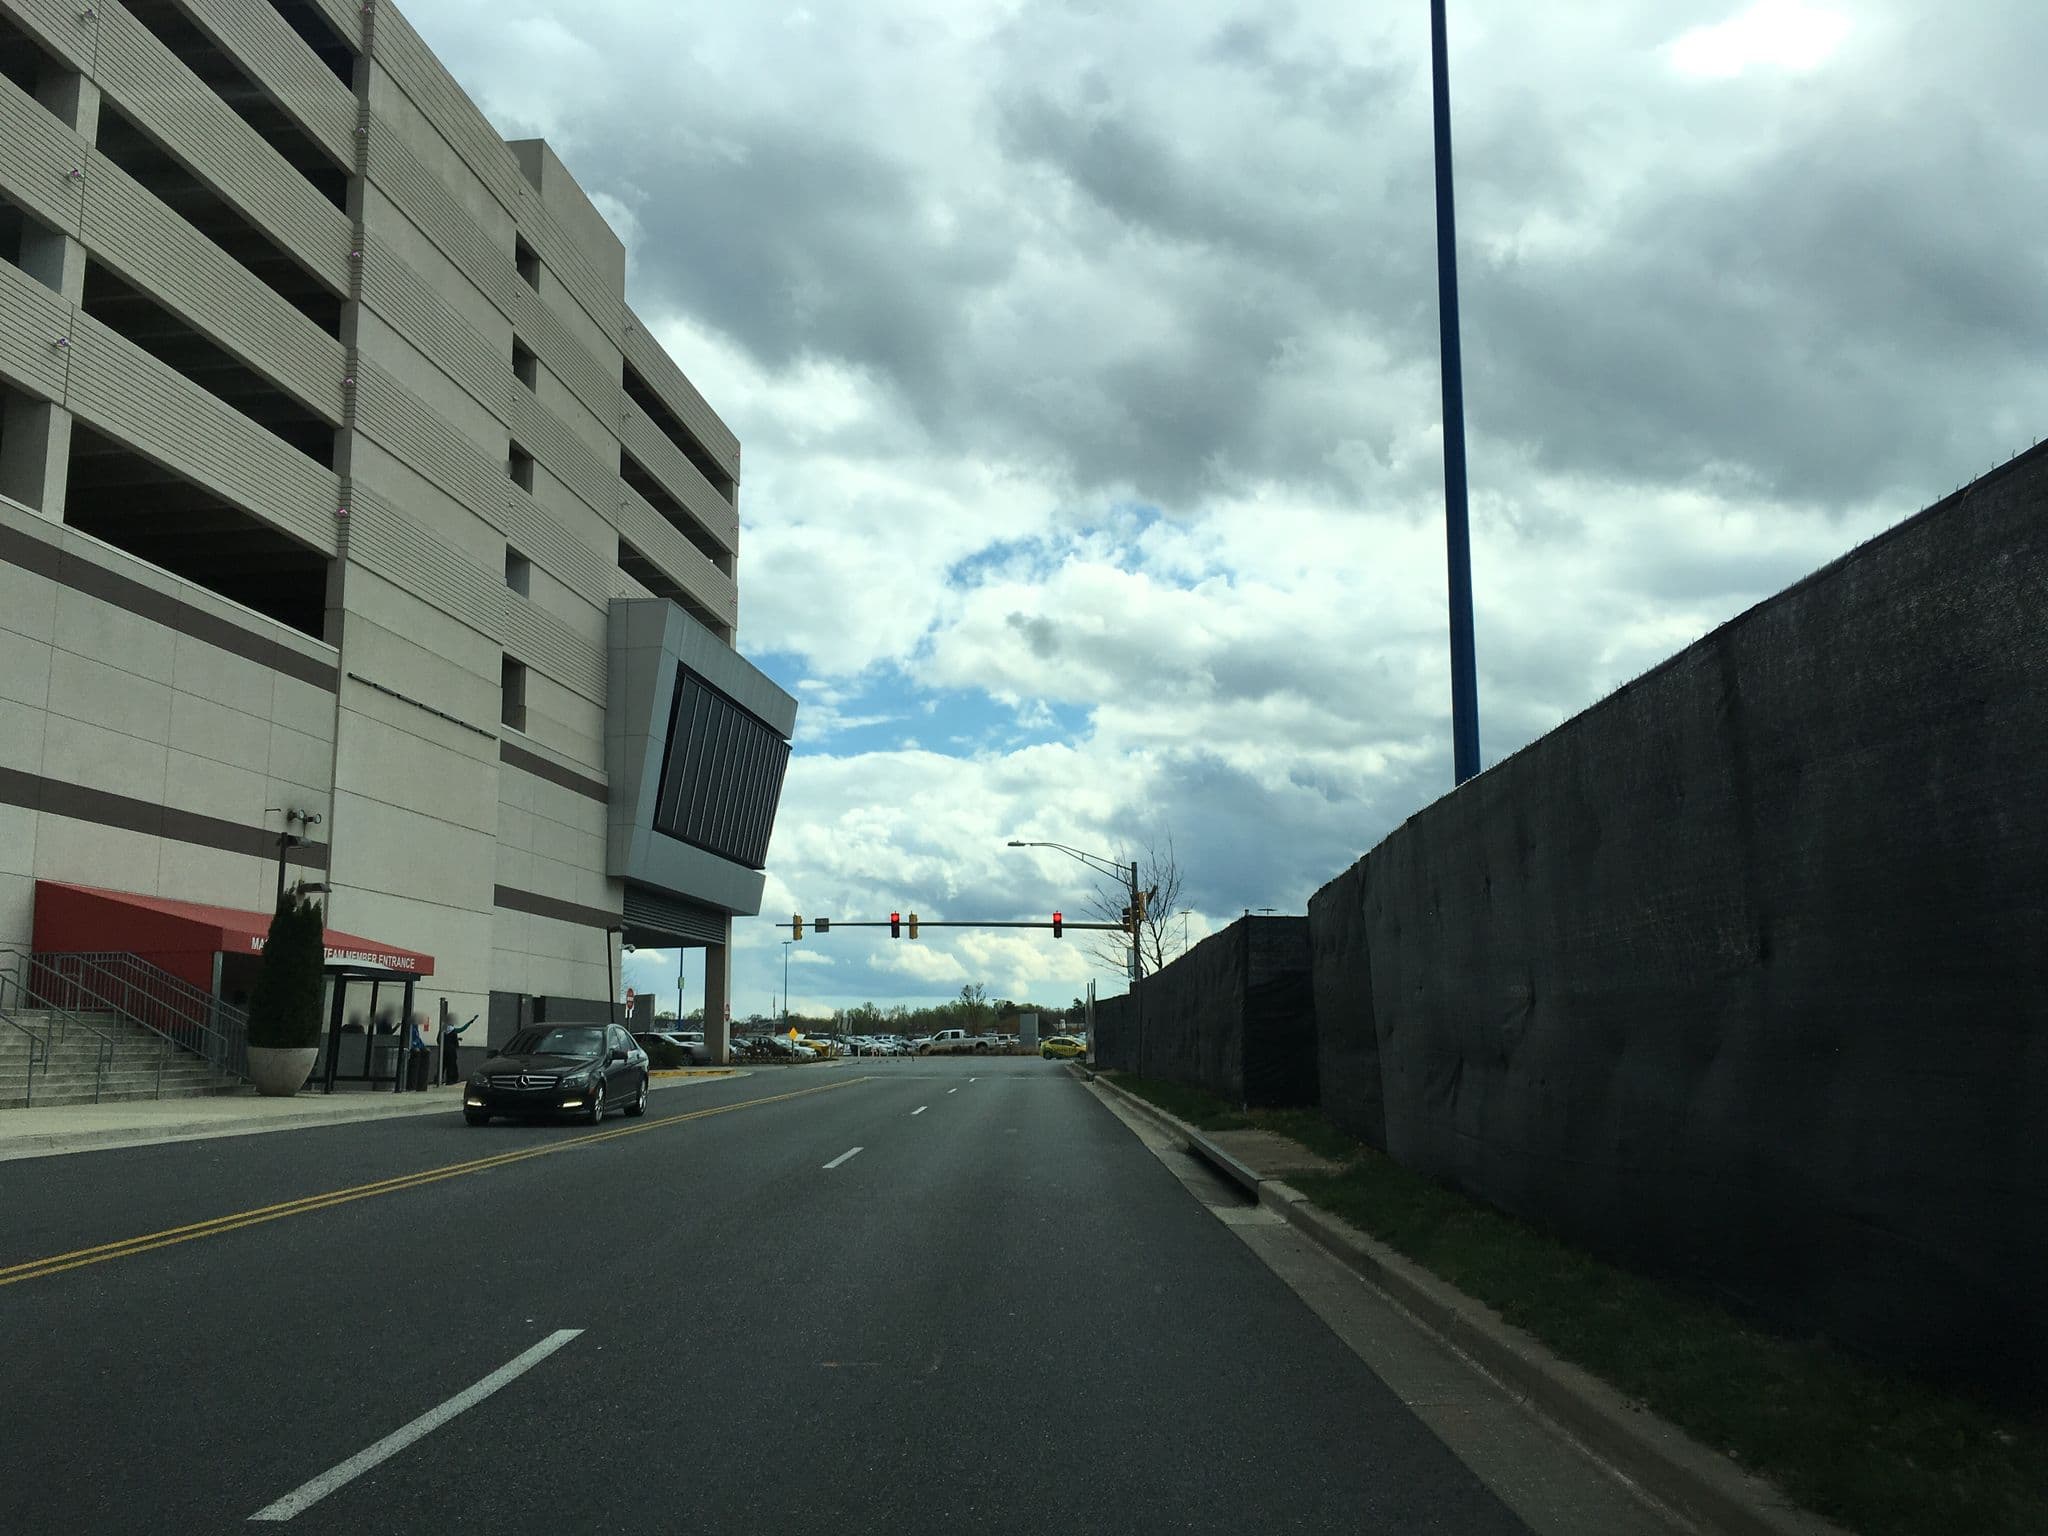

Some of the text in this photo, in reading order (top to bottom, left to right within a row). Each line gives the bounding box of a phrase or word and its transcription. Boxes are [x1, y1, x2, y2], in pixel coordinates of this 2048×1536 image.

[324, 948, 415, 969] TEAM MEMBER ENTRANCE
